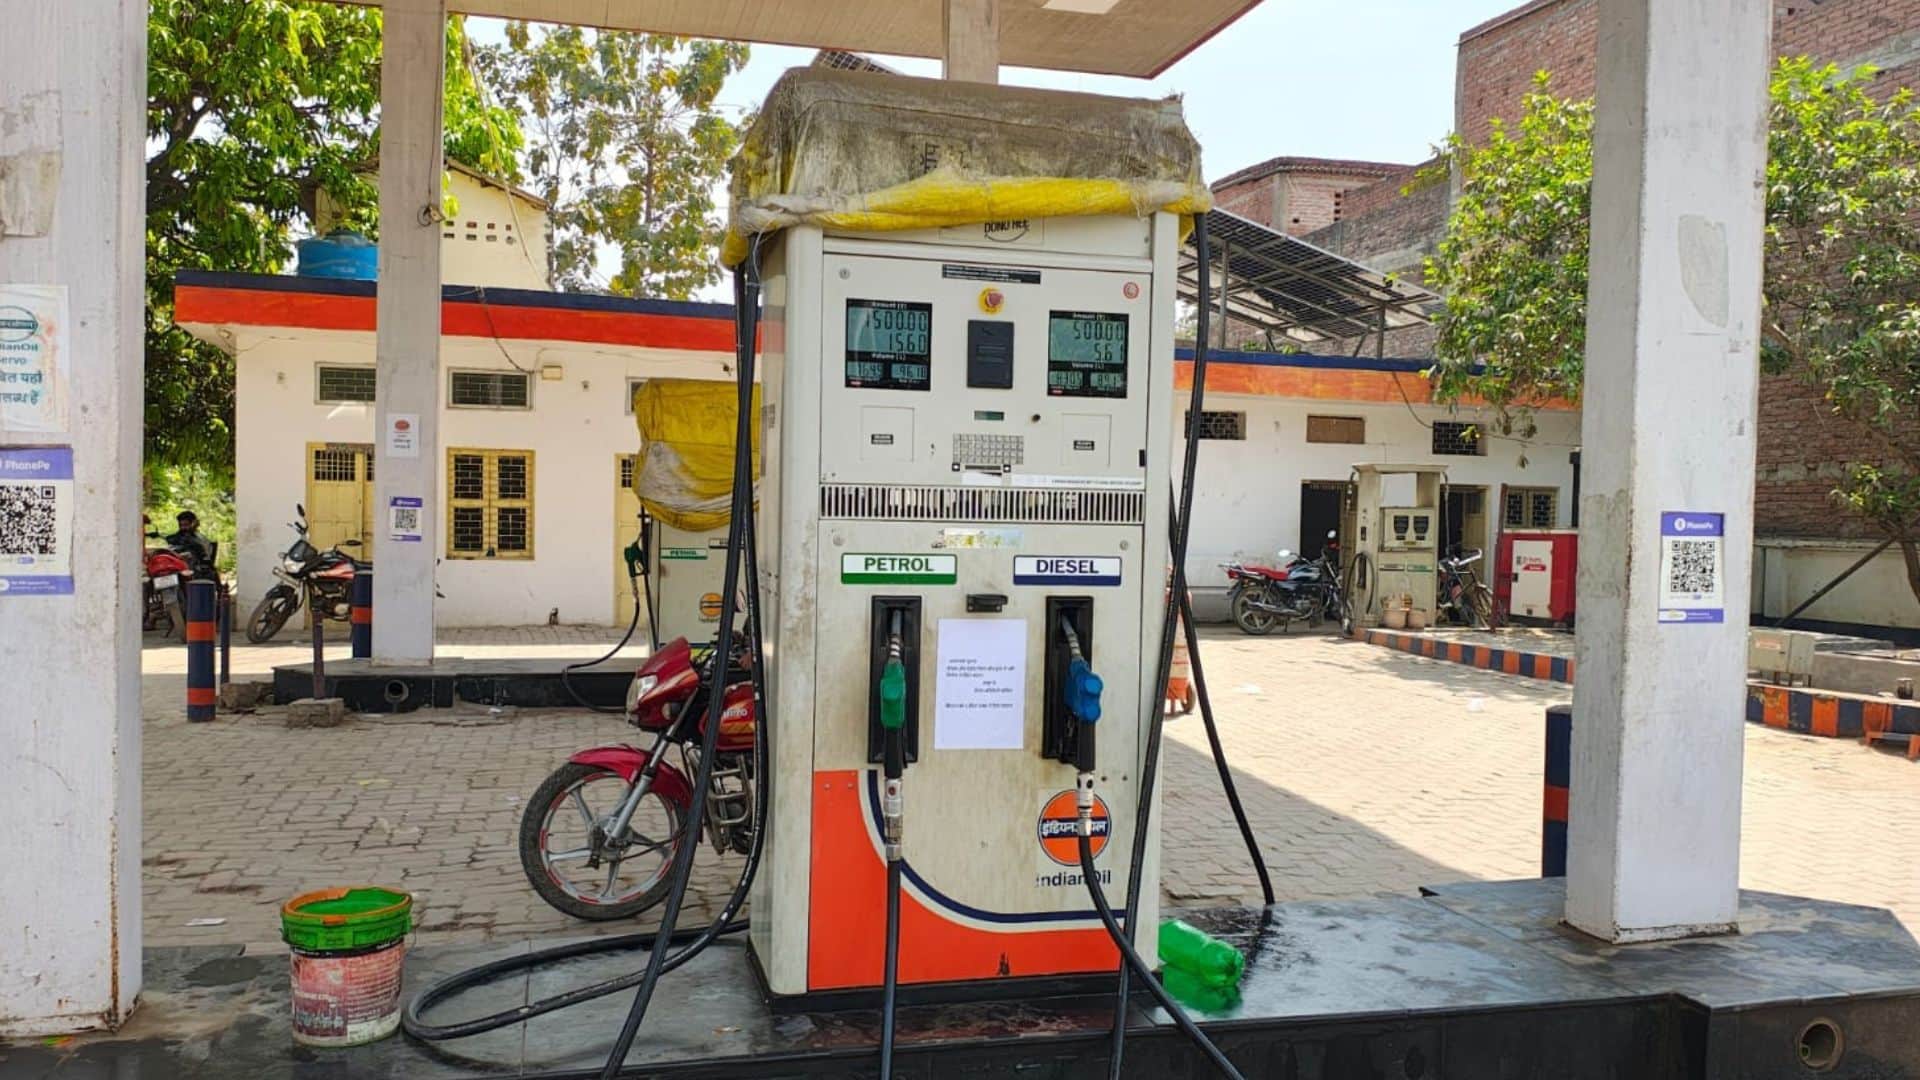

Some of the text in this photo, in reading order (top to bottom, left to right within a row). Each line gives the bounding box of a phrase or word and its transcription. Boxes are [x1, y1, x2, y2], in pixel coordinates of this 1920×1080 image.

[5, 460, 50, 471] PhonePe
[864, 557, 934, 572] PETROL
[1036, 559, 1099, 574] DIESEL
